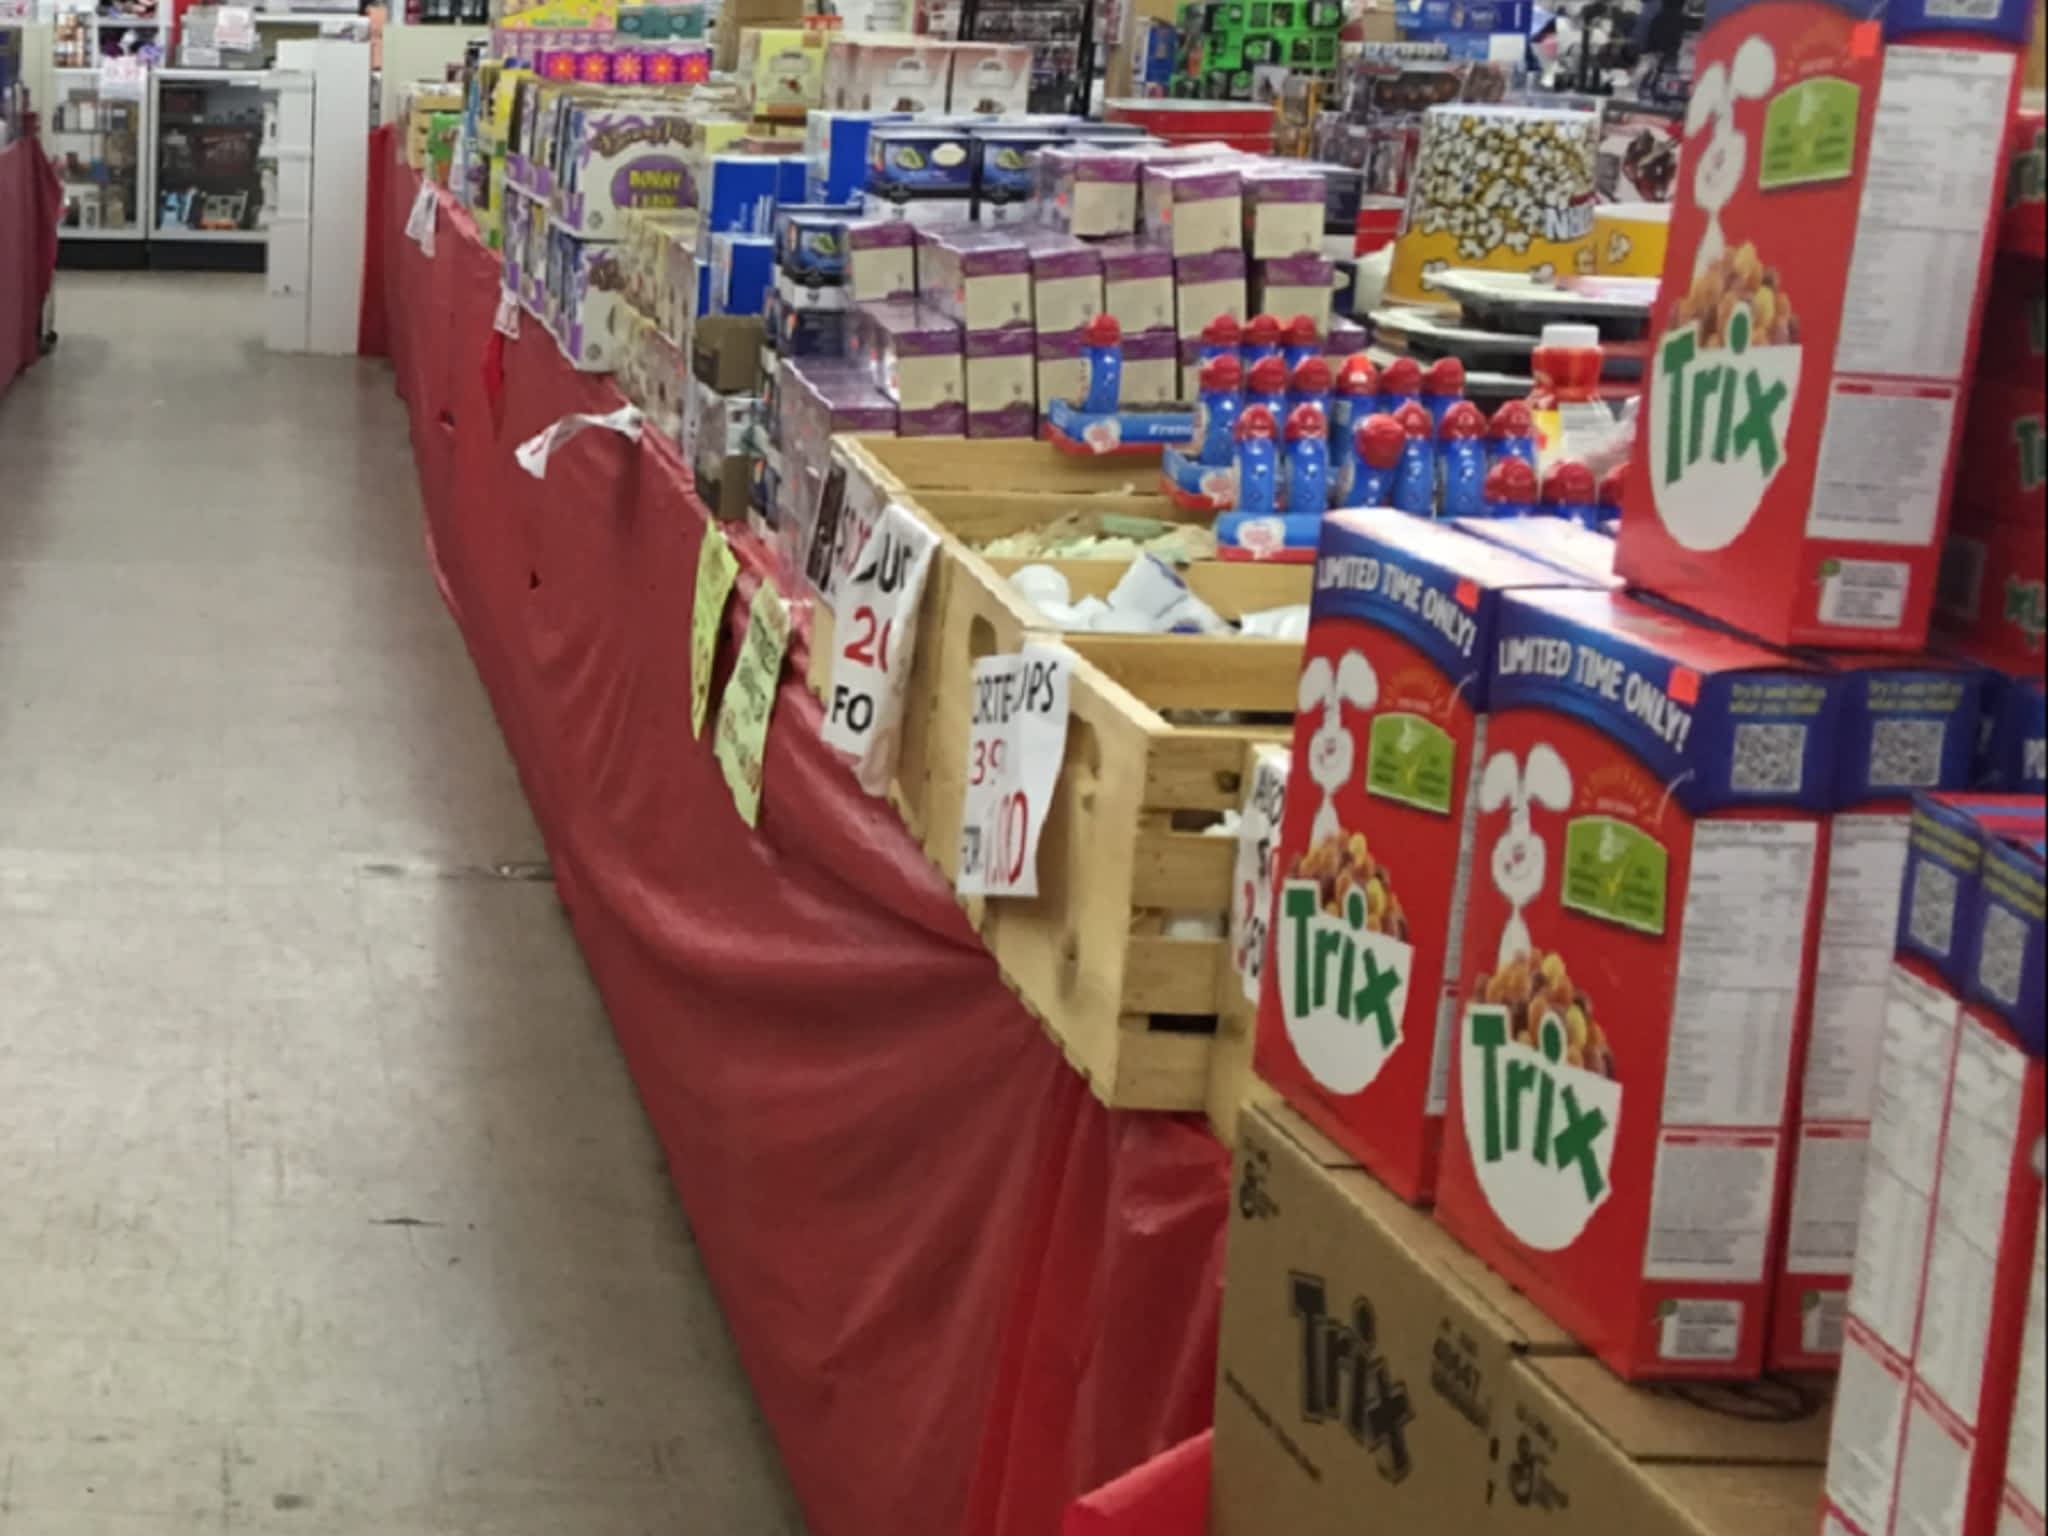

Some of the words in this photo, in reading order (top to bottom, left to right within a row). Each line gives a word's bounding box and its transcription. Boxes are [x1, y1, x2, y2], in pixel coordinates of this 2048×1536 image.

[1662, 311, 1788, 487] Trix
[1319, 556, 1380, 590] LIMITED
[1382, 563, 1424, 612] TIME
[1422, 587, 1477, 657] ONLY!
[1499, 638, 1571, 676] LIMITED
[1575, 645, 1625, 701] TIME
[1624, 672, 1691, 753] ONLY!
[1285, 886, 1402, 1050] Trix
[1472, 1012, 1608, 1202] Trix
[1290, 1272, 1414, 1484] Trix
